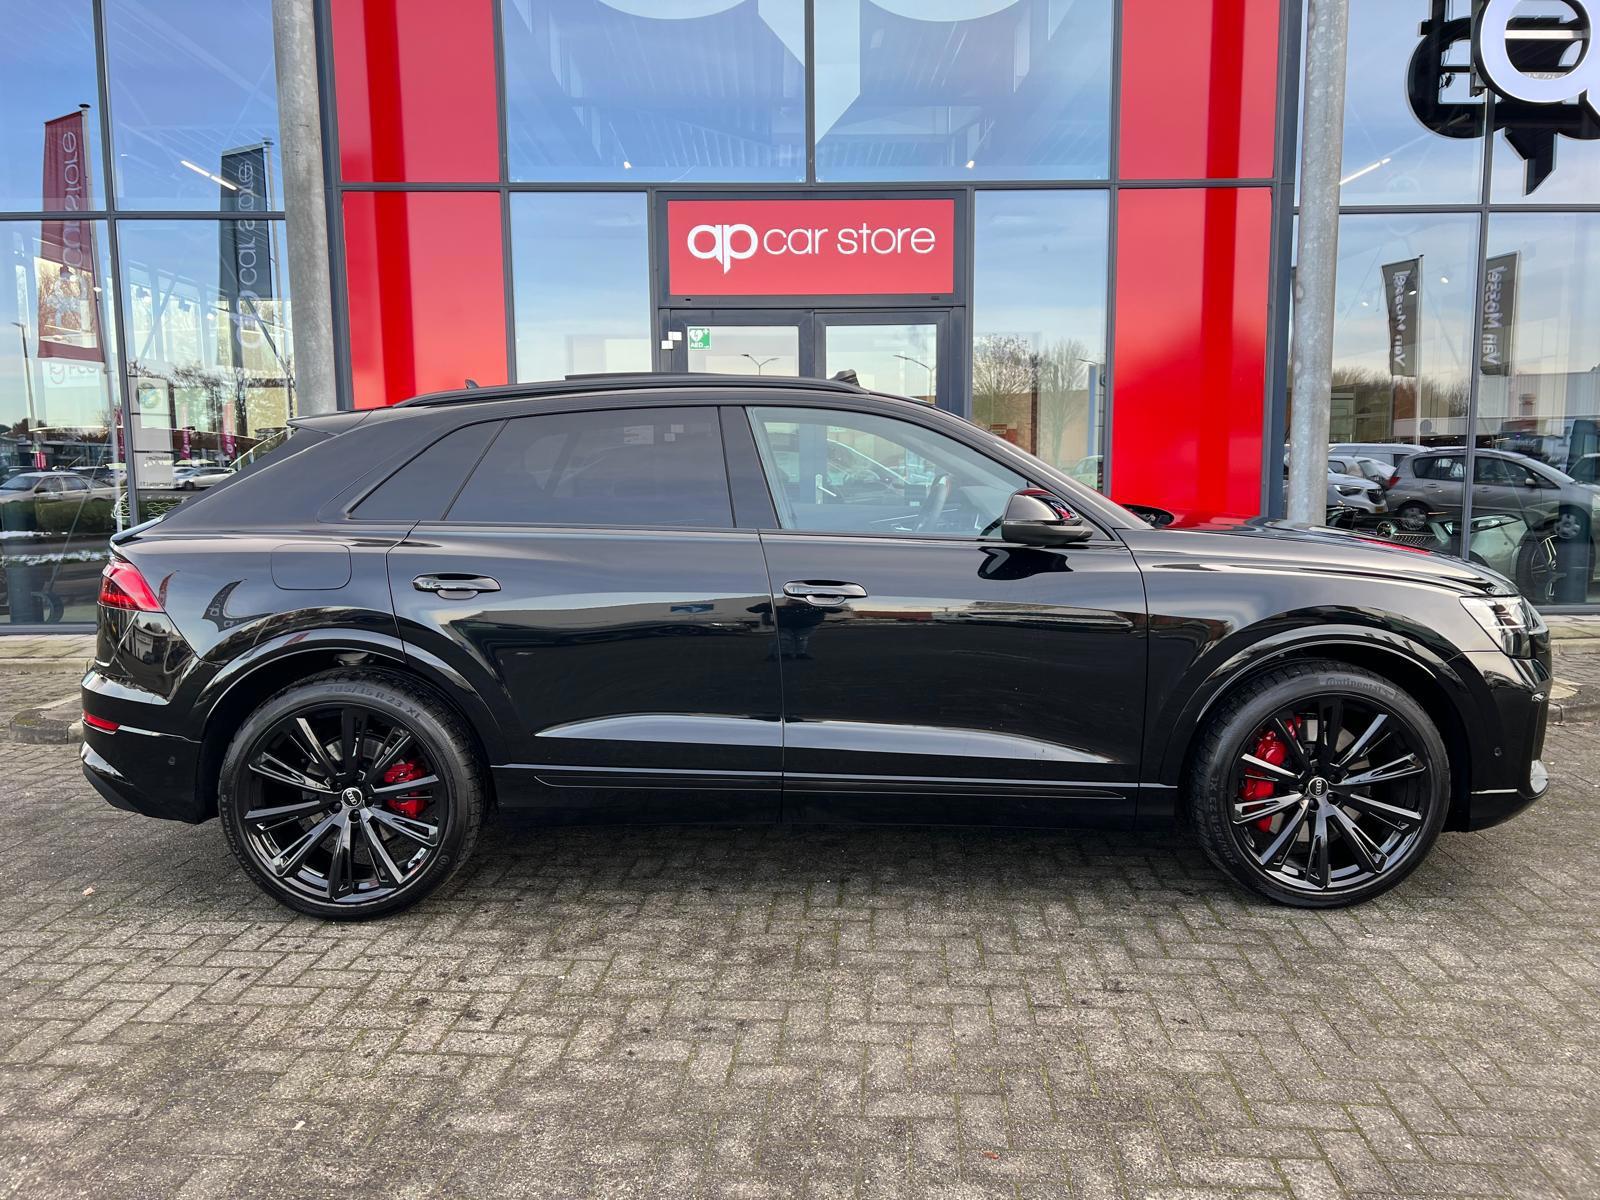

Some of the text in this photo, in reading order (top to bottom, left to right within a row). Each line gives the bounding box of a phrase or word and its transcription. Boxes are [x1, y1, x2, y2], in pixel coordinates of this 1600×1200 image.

[687, 222, 936, 274] ap car store
